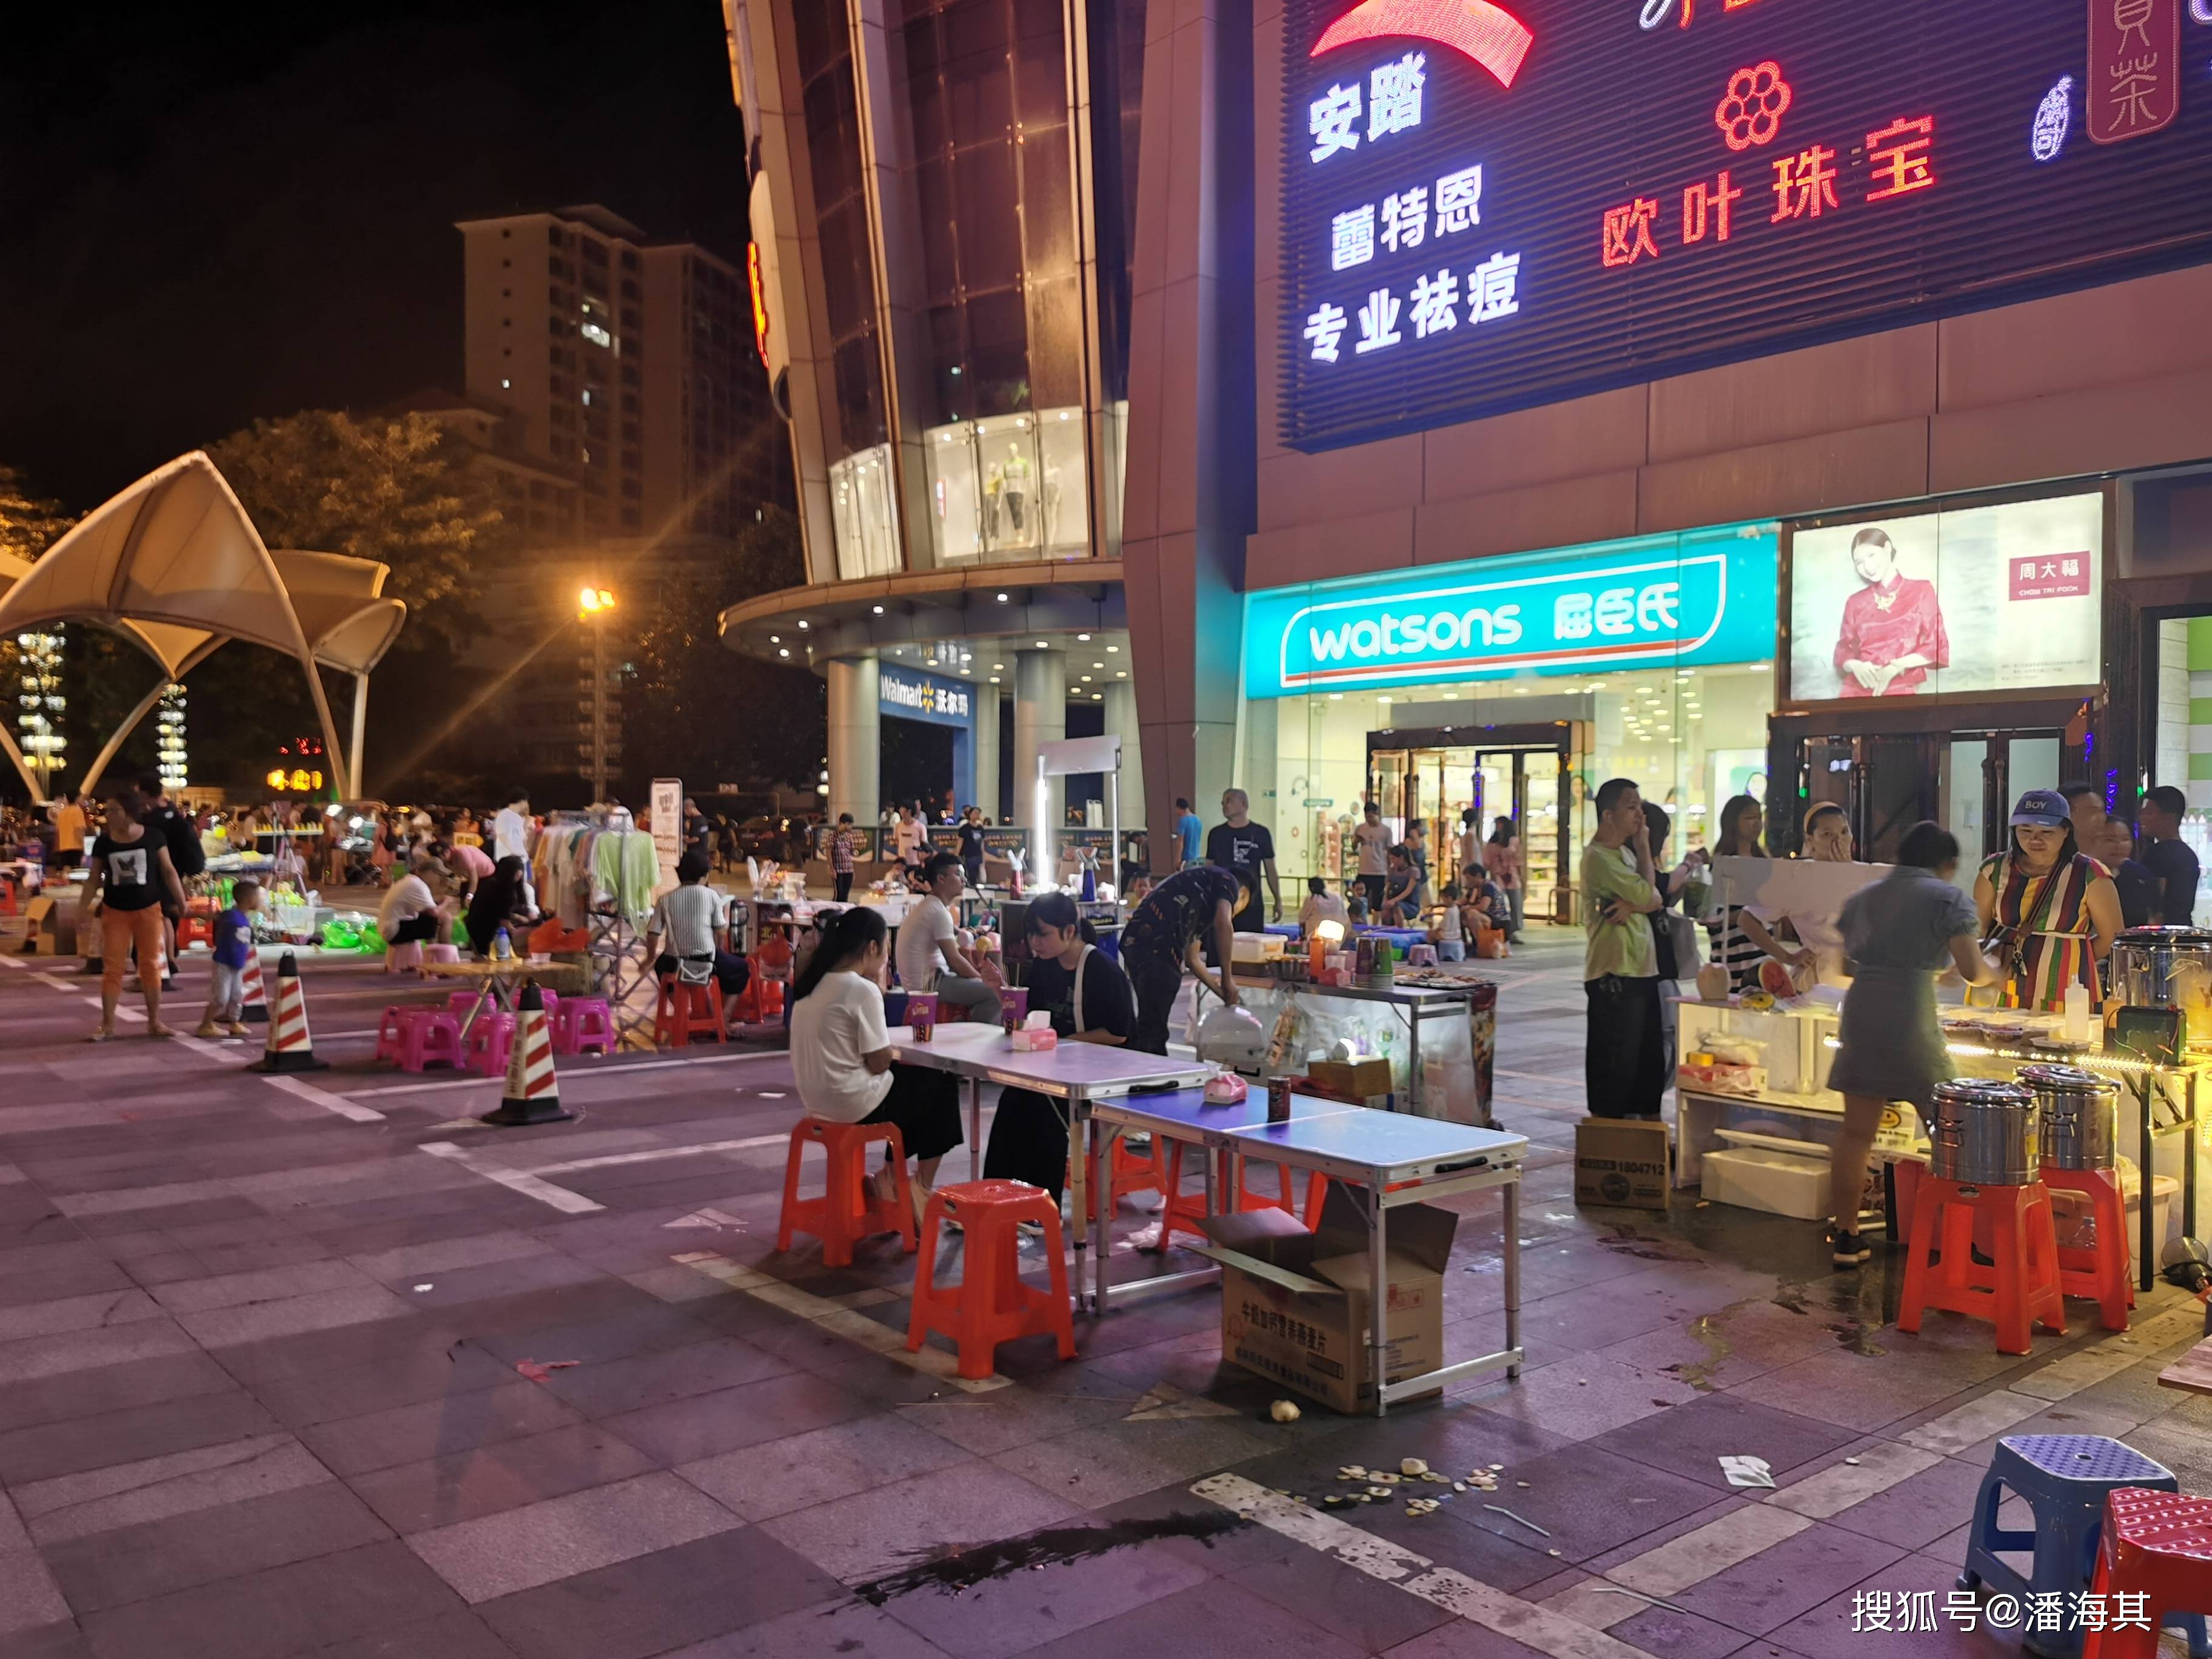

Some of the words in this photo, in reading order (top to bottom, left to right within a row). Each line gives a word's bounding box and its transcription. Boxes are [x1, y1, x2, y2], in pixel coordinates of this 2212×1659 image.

[1308, 51, 1426, 164] 安踏
[1331, 164, 1483, 271] 蕾特恩
[1601, 115, 1936, 268] 欧叶珠宝
[1304, 251, 1520, 363] 专业祛痘
[2019, 559, 2079, 581] 周大福
[1310, 605, 1523, 662] watsons
[1553, 582, 1679, 640] 屈臣氏
[880, 674, 923, 708] Walmart
[935, 688, 968, 717] 沃尔玛
[2025, 800, 2047, 809] BOY
